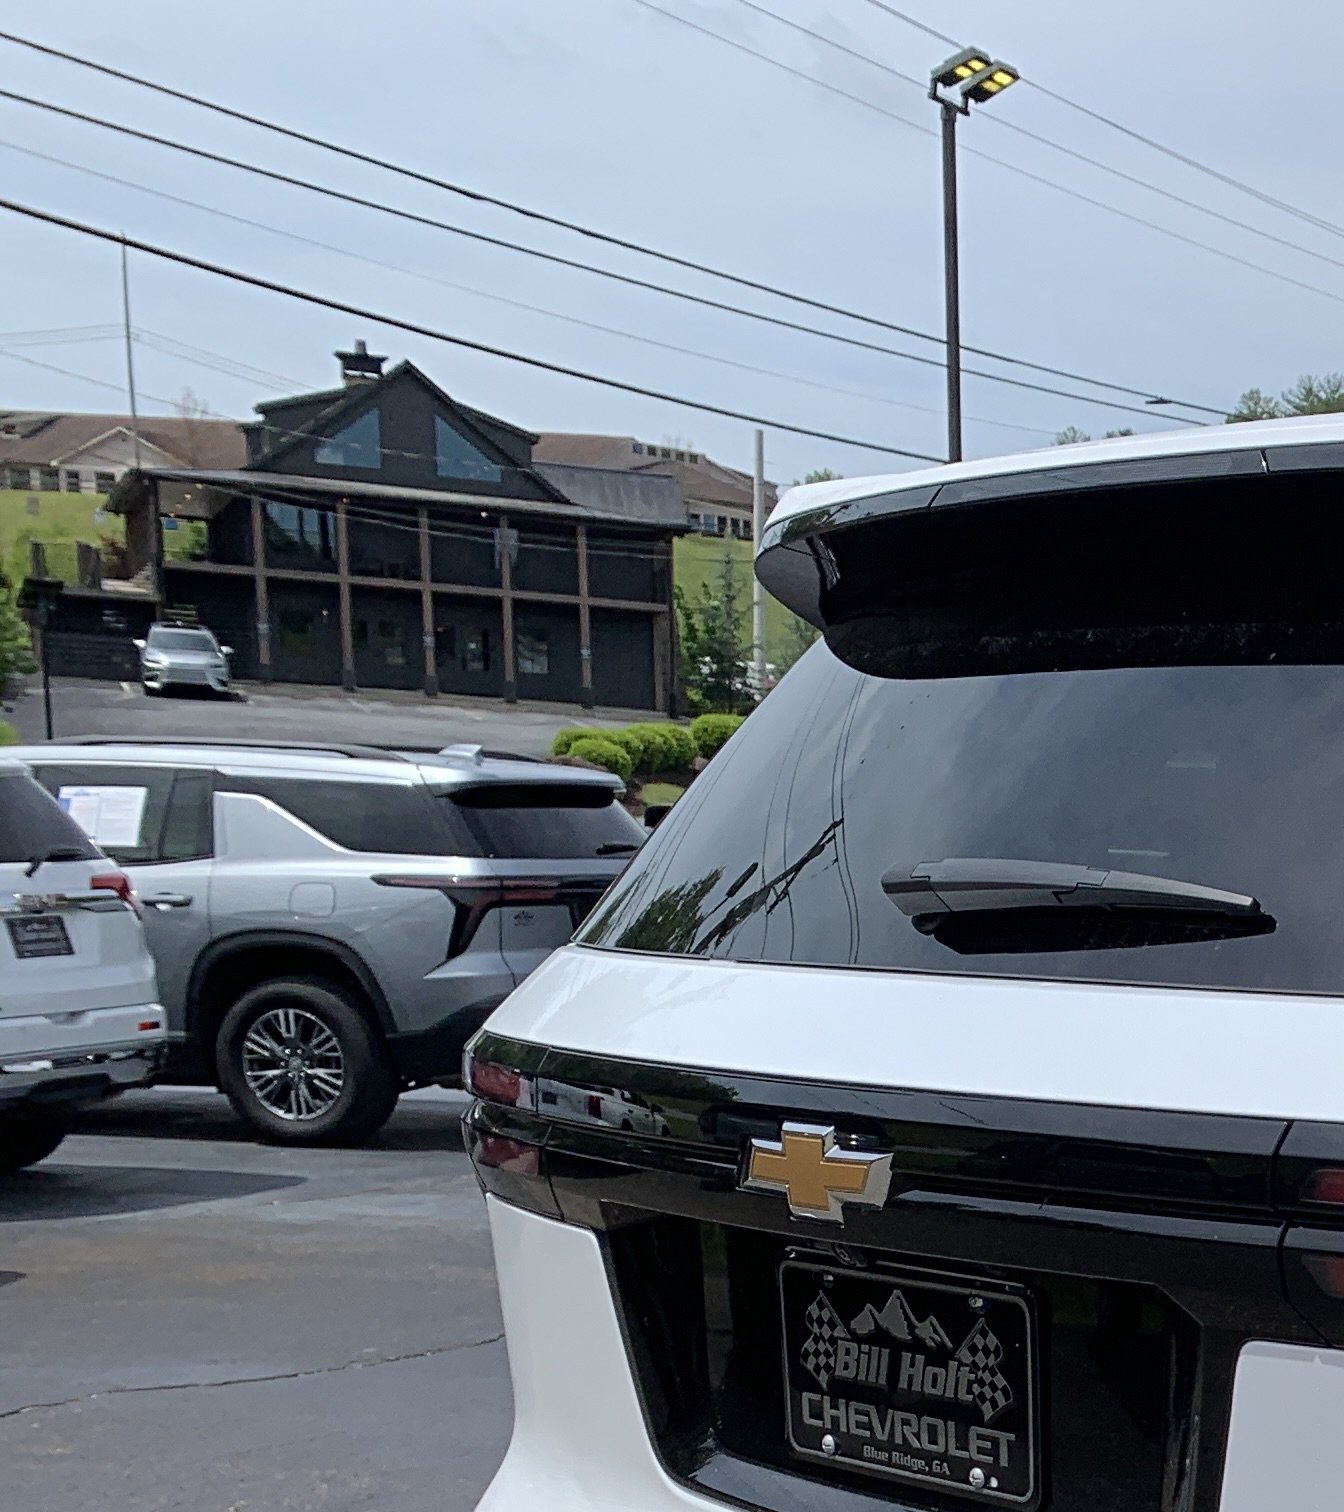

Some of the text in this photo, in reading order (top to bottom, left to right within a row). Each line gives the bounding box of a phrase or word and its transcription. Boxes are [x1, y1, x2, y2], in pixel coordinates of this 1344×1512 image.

[834, 1339, 977, 1402] Bill Holt
[801, 1391, 1016, 1468] CHEVROLET
[863, 1445, 951, 1476] Blue Ridge, GA
